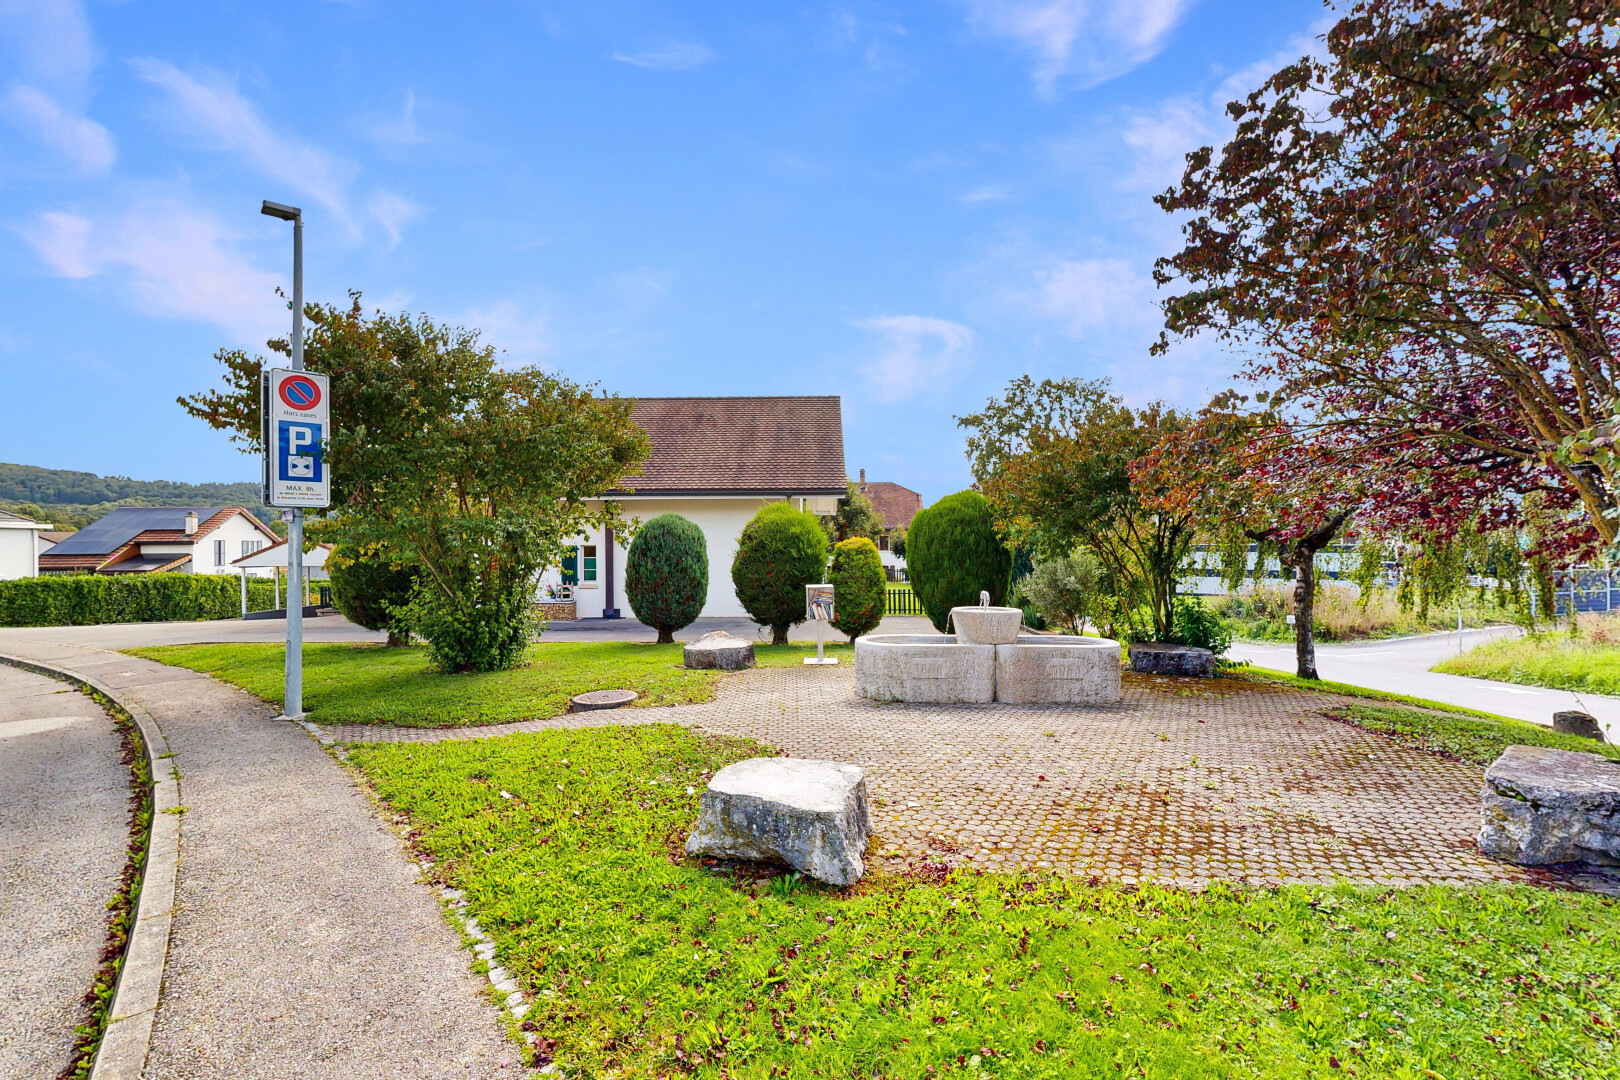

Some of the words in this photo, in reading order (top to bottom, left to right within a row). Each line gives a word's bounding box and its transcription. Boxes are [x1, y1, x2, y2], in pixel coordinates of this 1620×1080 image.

[283, 409, 299, 417] Hors
[300, 411, 317, 419] cases
[289, 425, 312, 455] P
